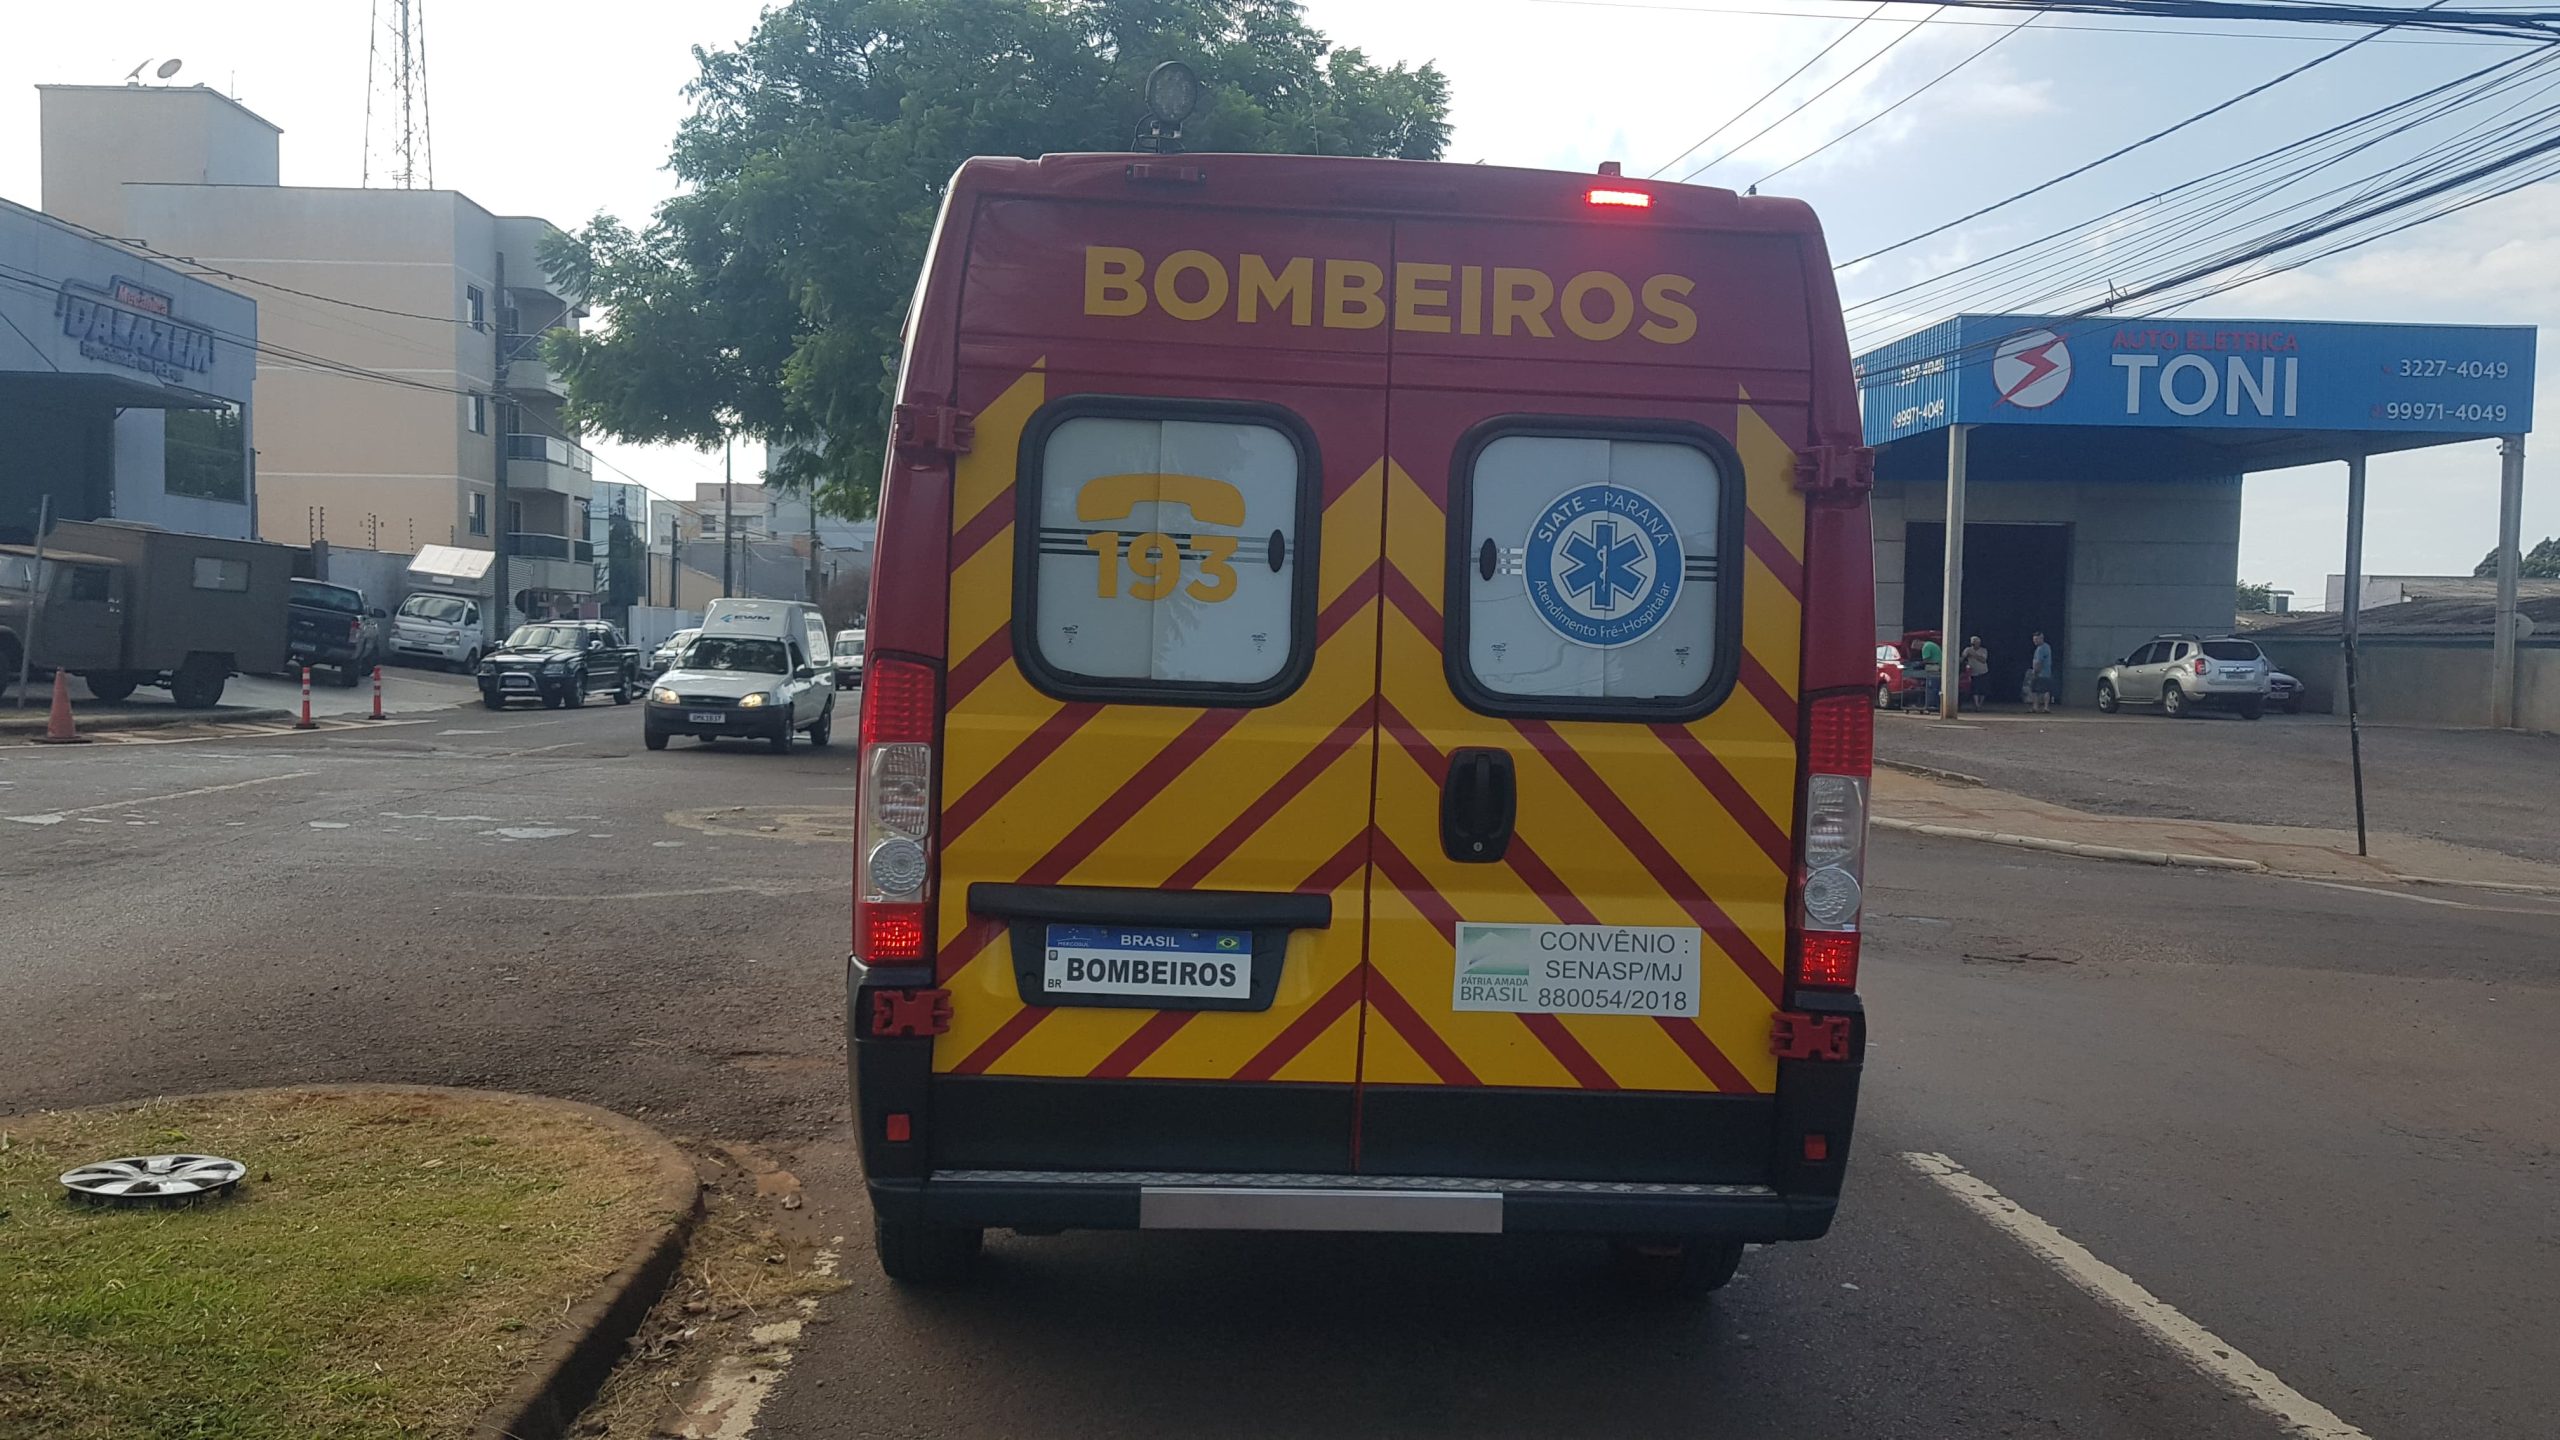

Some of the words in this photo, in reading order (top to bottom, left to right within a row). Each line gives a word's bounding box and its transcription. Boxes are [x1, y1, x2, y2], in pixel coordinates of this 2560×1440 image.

[1083, 244, 1699, 345] BOMBEIROS
[2112, 330, 2179, 349] AUTO
[2399, 359, 2509, 378] 3227-4049
[2111, 353, 2298, 416] TONI
[1895, 398, 1944, 428] 99971-4049
[2386, 402, 2507, 421] 99971-4049
[1538, 496, 1586, 543] SIATE
[1604, 491, 1673, 547] PARANÁ
[1086, 531, 1238, 603] 193
[1535, 579, 1597, 637] Atendimento
[1120, 934, 1179, 948] BRASIL
[1540, 930, 1675, 953] CONVÊNIO
[1066, 957, 1236, 987] BOMBEIROS
[1461, 975, 1493, 986] PÁTRIA
[1494, 977, 1529, 987] AMADA
[1545, 960, 1683, 982] SENASP/MJ
[1047, 978, 1062, 988] BR
[1460, 986, 1529, 1003] BRASIL
[1538, 988, 1687, 1011] 880054/2018
